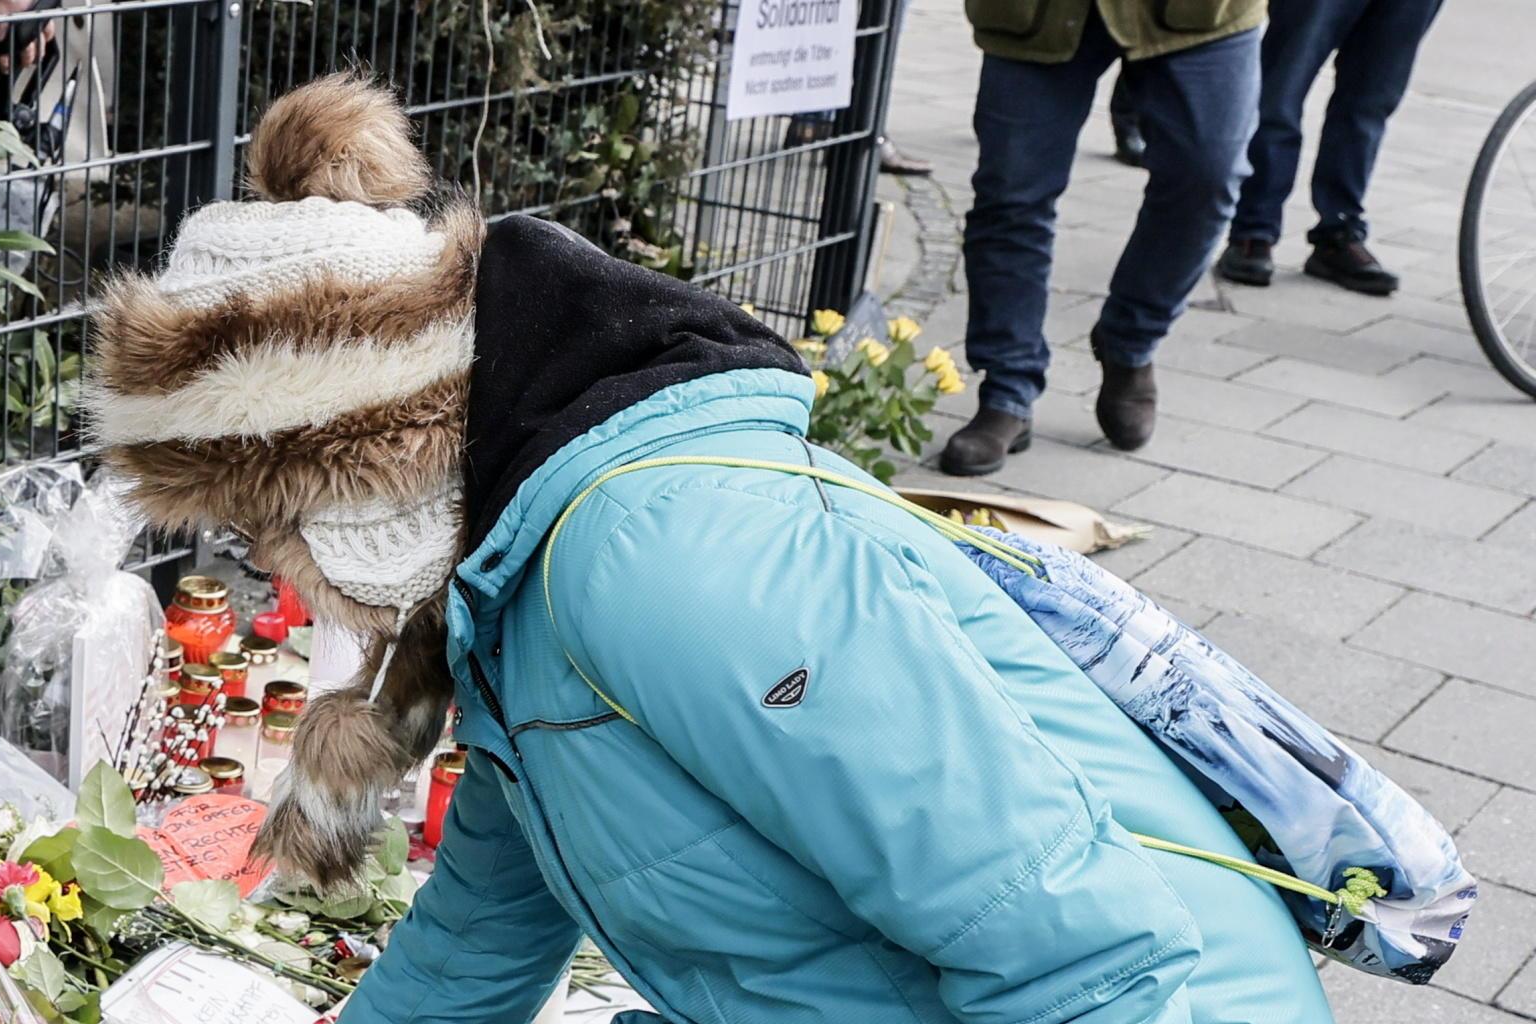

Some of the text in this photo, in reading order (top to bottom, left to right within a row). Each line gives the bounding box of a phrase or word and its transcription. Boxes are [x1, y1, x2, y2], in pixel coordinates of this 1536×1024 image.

[768, 671, 805, 703] LIMO LADY
[170, 803, 220, 818] FÜR
[202, 803, 257, 823] OPFER
[182, 822, 259, 848] RECHTE
[193, 989, 229, 1024] KEIN
